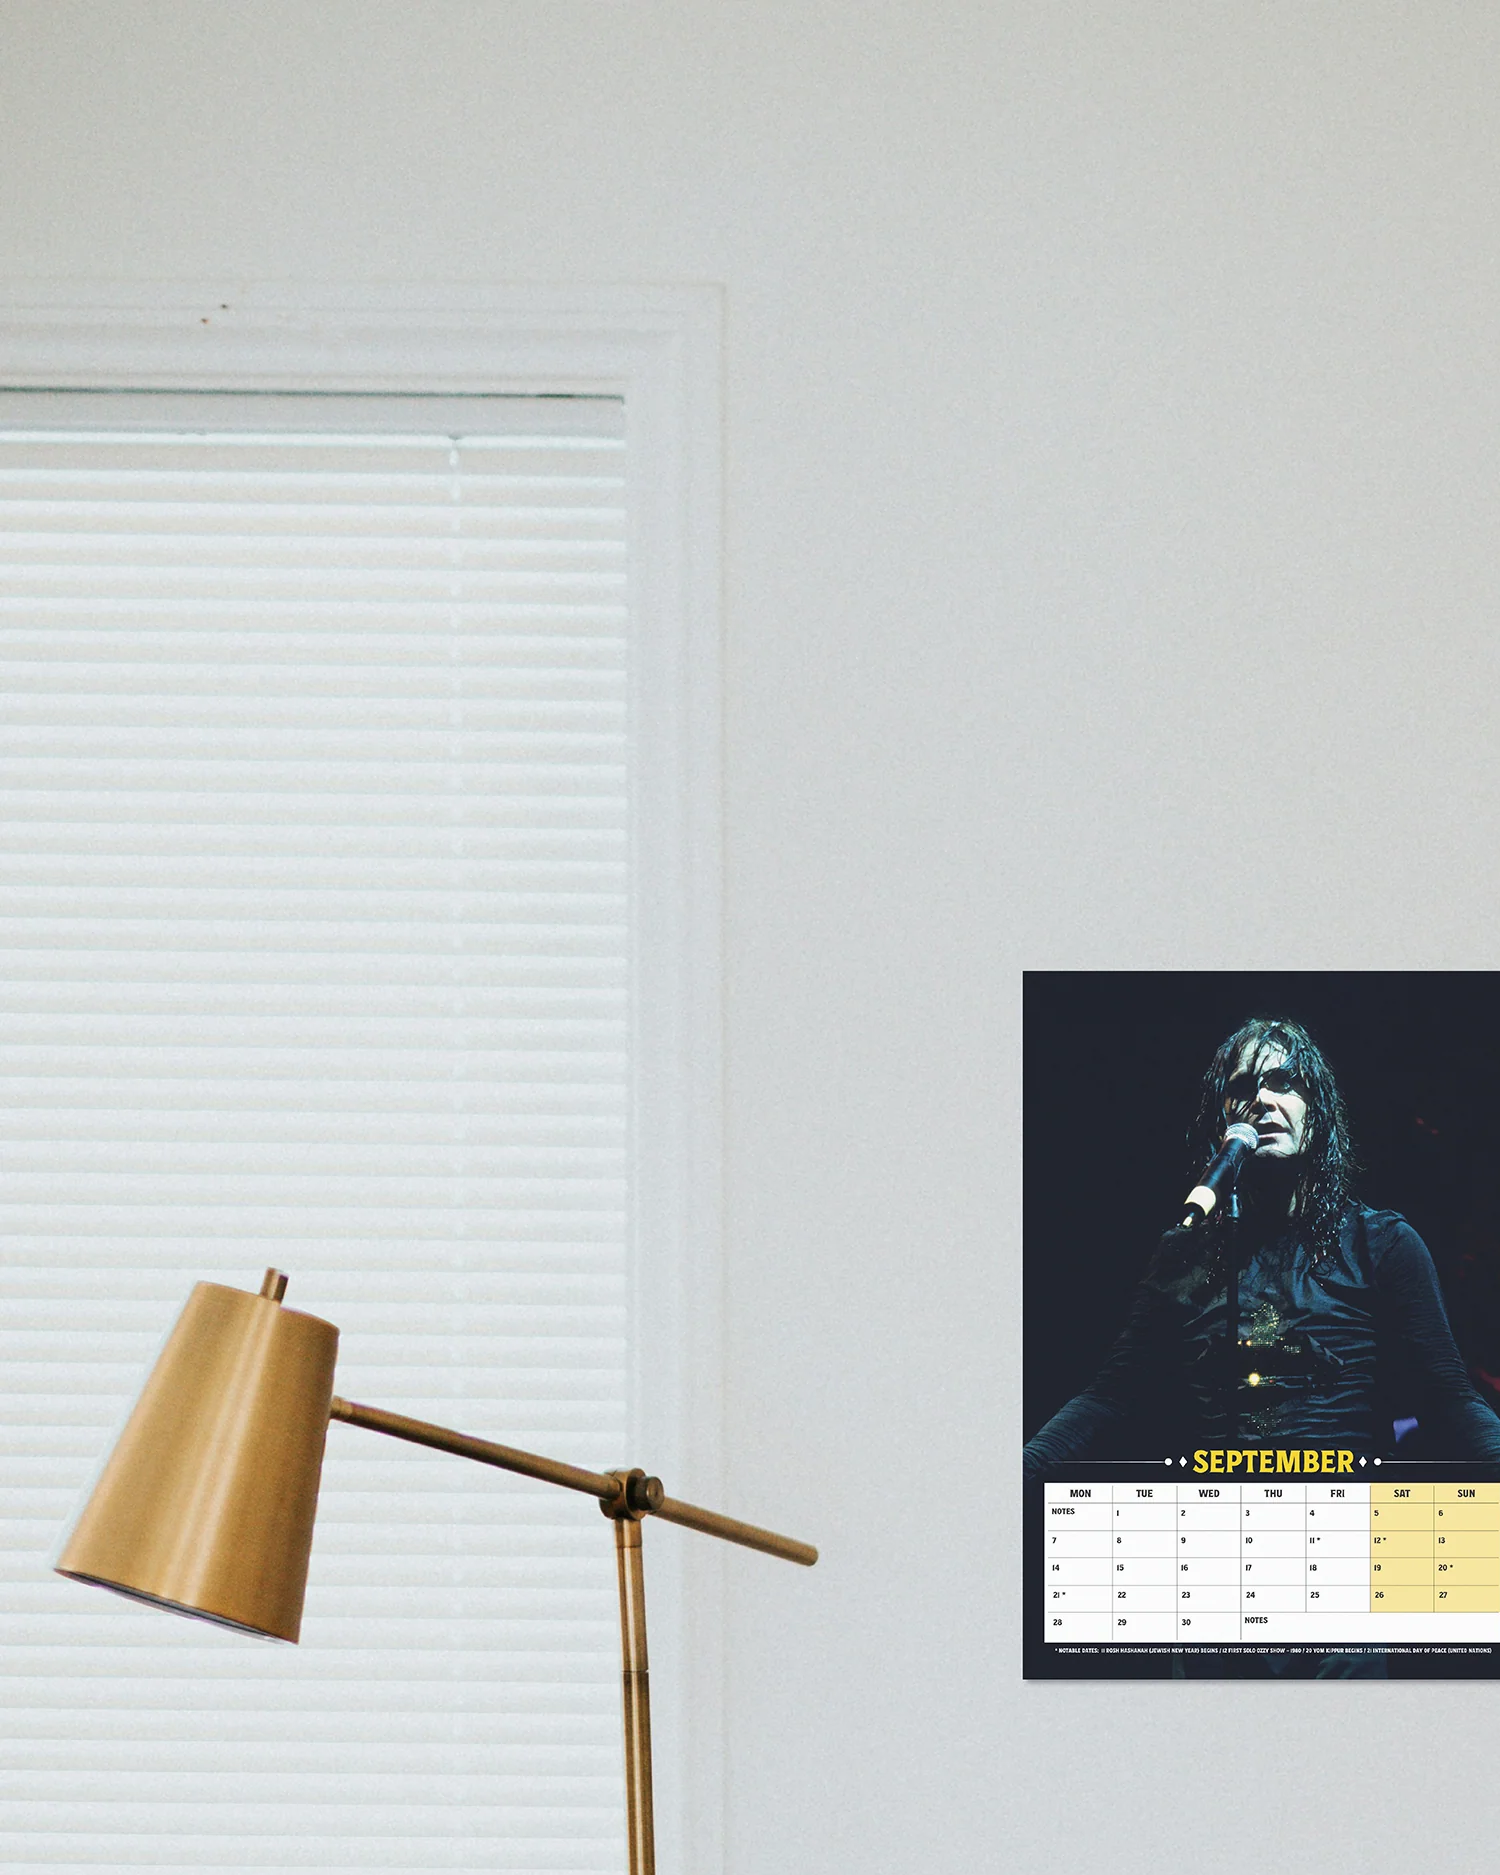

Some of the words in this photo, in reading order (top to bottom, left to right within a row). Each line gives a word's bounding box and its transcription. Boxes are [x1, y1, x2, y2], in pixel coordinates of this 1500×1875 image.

[1193, 1450, 1354, 1473] SEPTEMBER
[1394, 1489, 1410, 1497] SAT
[1458, 1489, 1475, 1497] SUN
[1116, 1564, 1124, 1572] 15
[1180, 1564, 1188, 1572] 16
[1246, 1564, 1252, 1572] 17
[1310, 1564, 1318, 1572] 18
[1374, 1564, 1382, 1572] 19
[1438, 1564, 1448, 1572] 20
